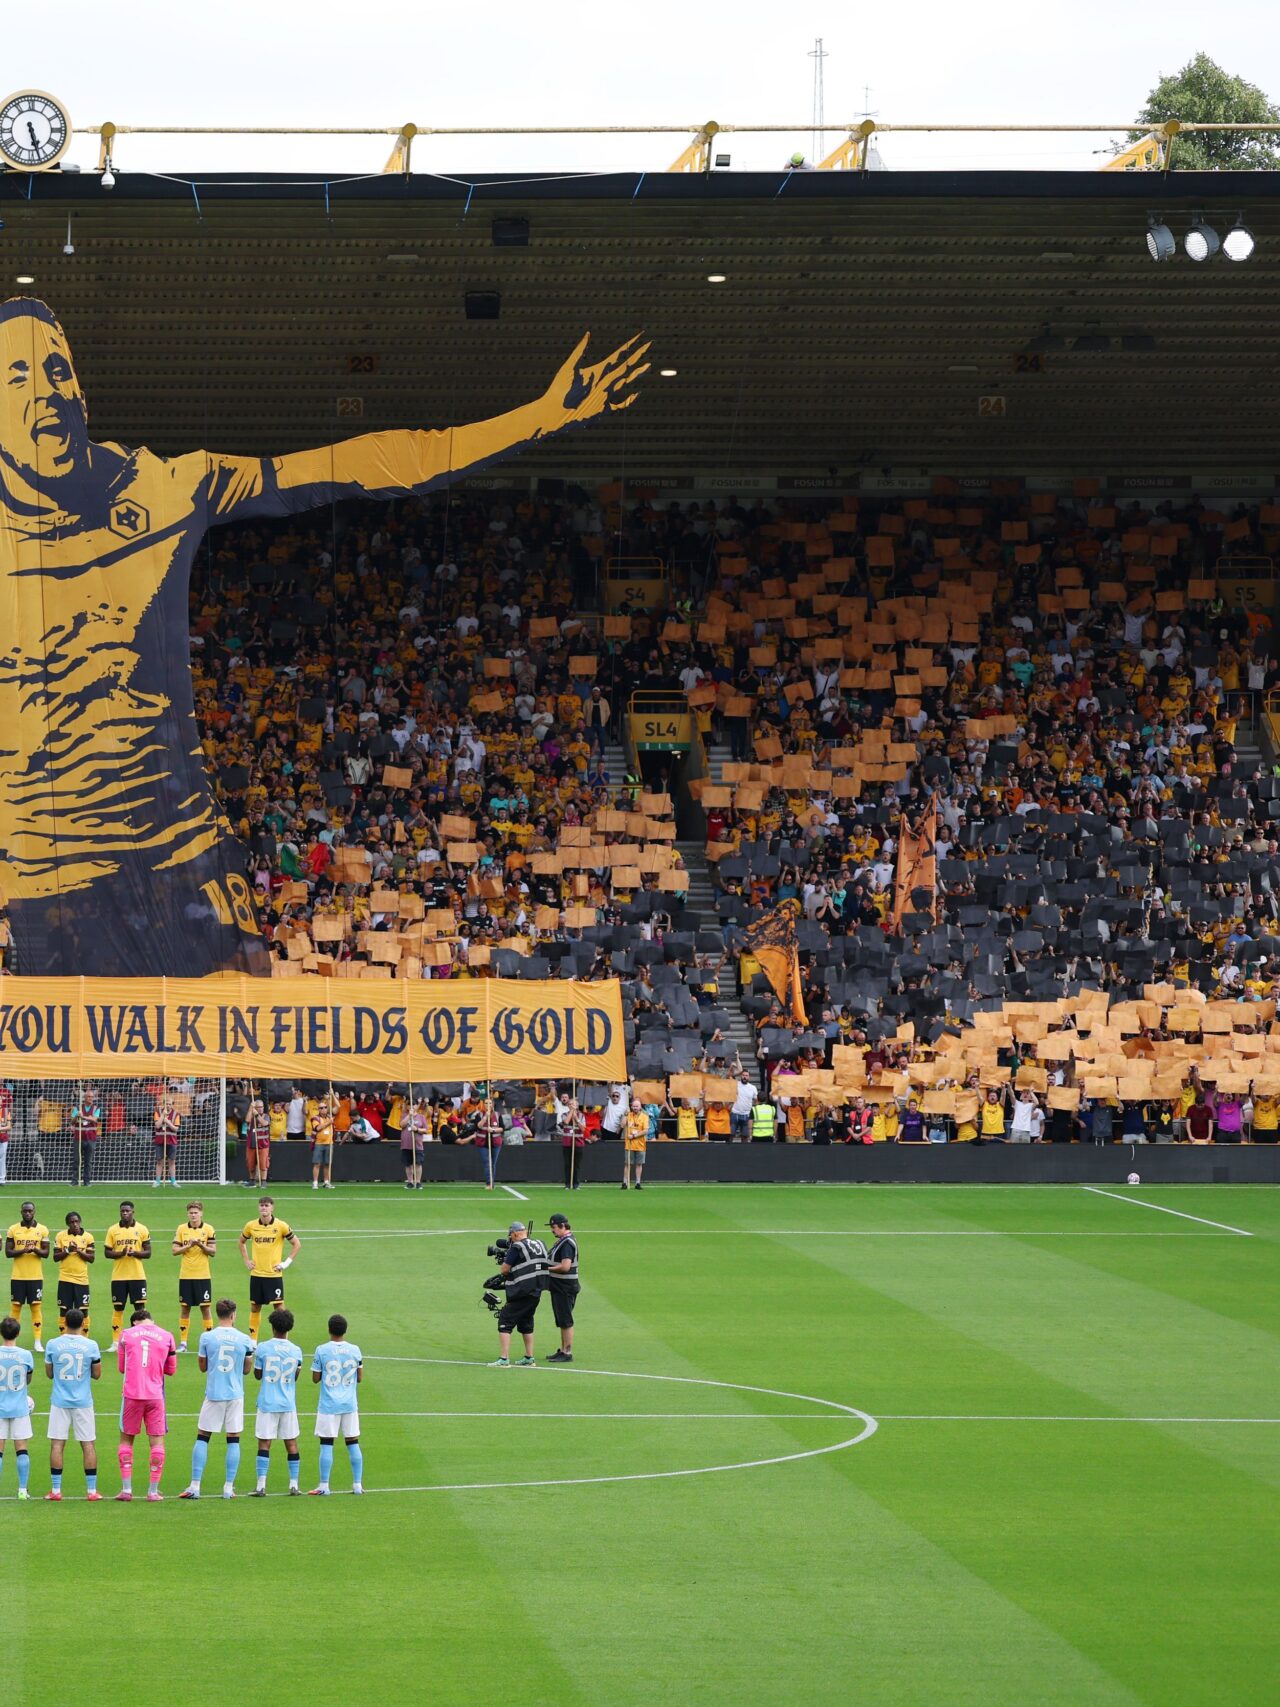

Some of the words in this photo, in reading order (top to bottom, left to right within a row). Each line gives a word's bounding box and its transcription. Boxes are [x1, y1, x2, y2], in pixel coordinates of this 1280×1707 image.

[350, 356, 374, 372] 23
[1017, 355, 1040, 370] 24
[340, 398, 361, 416] 23
[980, 398, 1003, 415] 24
[625, 588, 645, 601] S4
[1235, 588, 1256, 600] S5
[645, 722, 676, 736] SL4
[199, 873, 262, 935] 18
[85, 1005, 206, 1054] WALK
[220, 1005, 261, 1054] IN
[270, 1006, 408, 1055] FIELDS
[421, 1006, 479, 1056] OF
[490, 1006, 614, 1056] GOLD
[142, 1288, 146, 1297] 5
[204, 1290, 209, 1300] 6
[275, 1289, 281, 1298] 9
[141, 1340, 149, 1367] 1
[218, 1345, 235, 1372] 5
[59, 1353, 84, 1380] 21
[265, 1356, 297, 1384] 52
[326, 1360, 357, 1387] 82
